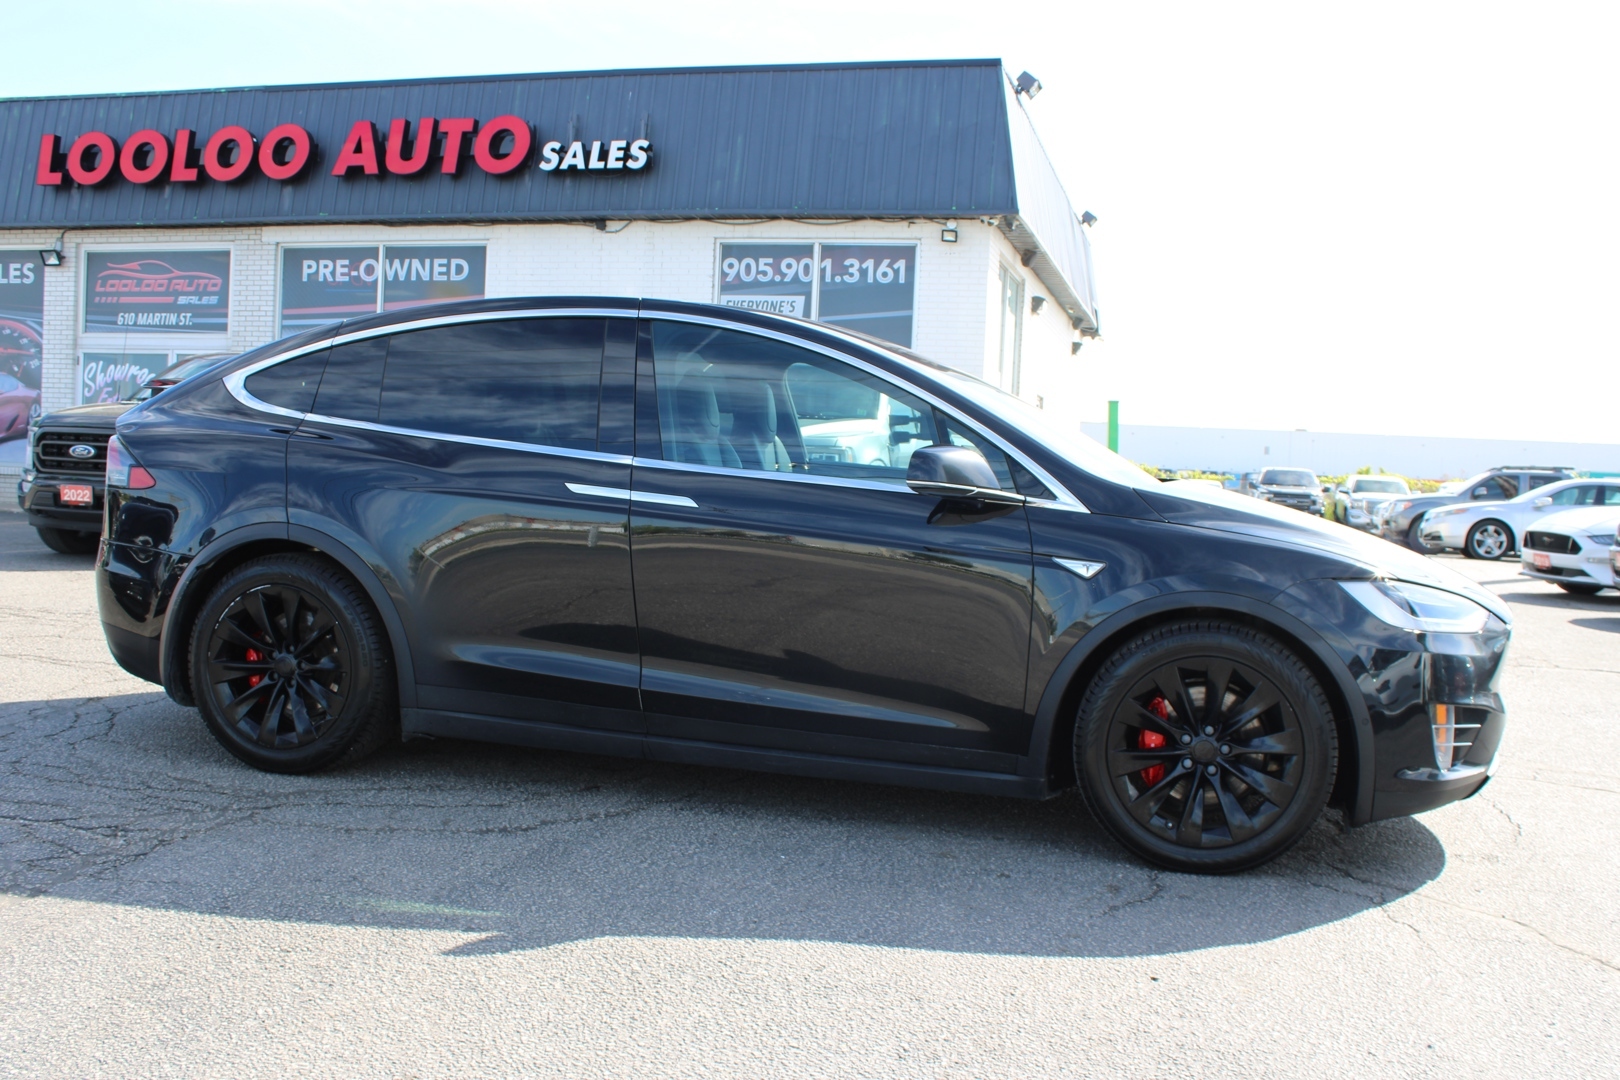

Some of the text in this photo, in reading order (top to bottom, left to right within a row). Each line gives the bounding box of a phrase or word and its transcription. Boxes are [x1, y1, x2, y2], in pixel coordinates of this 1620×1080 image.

[37, 114, 651, 186] LOOLOO AUTO SALES
[302, 258, 470, 282] PRE-OWNED
[722, 257, 906, 284] 905.901.3161
[95, 279, 222, 292] LOOLOO AUTO
[177, 296, 219, 304] SALES
[117, 313, 193, 325] 610 MARTIN ST.
[64, 489, 90, 502] 2022
